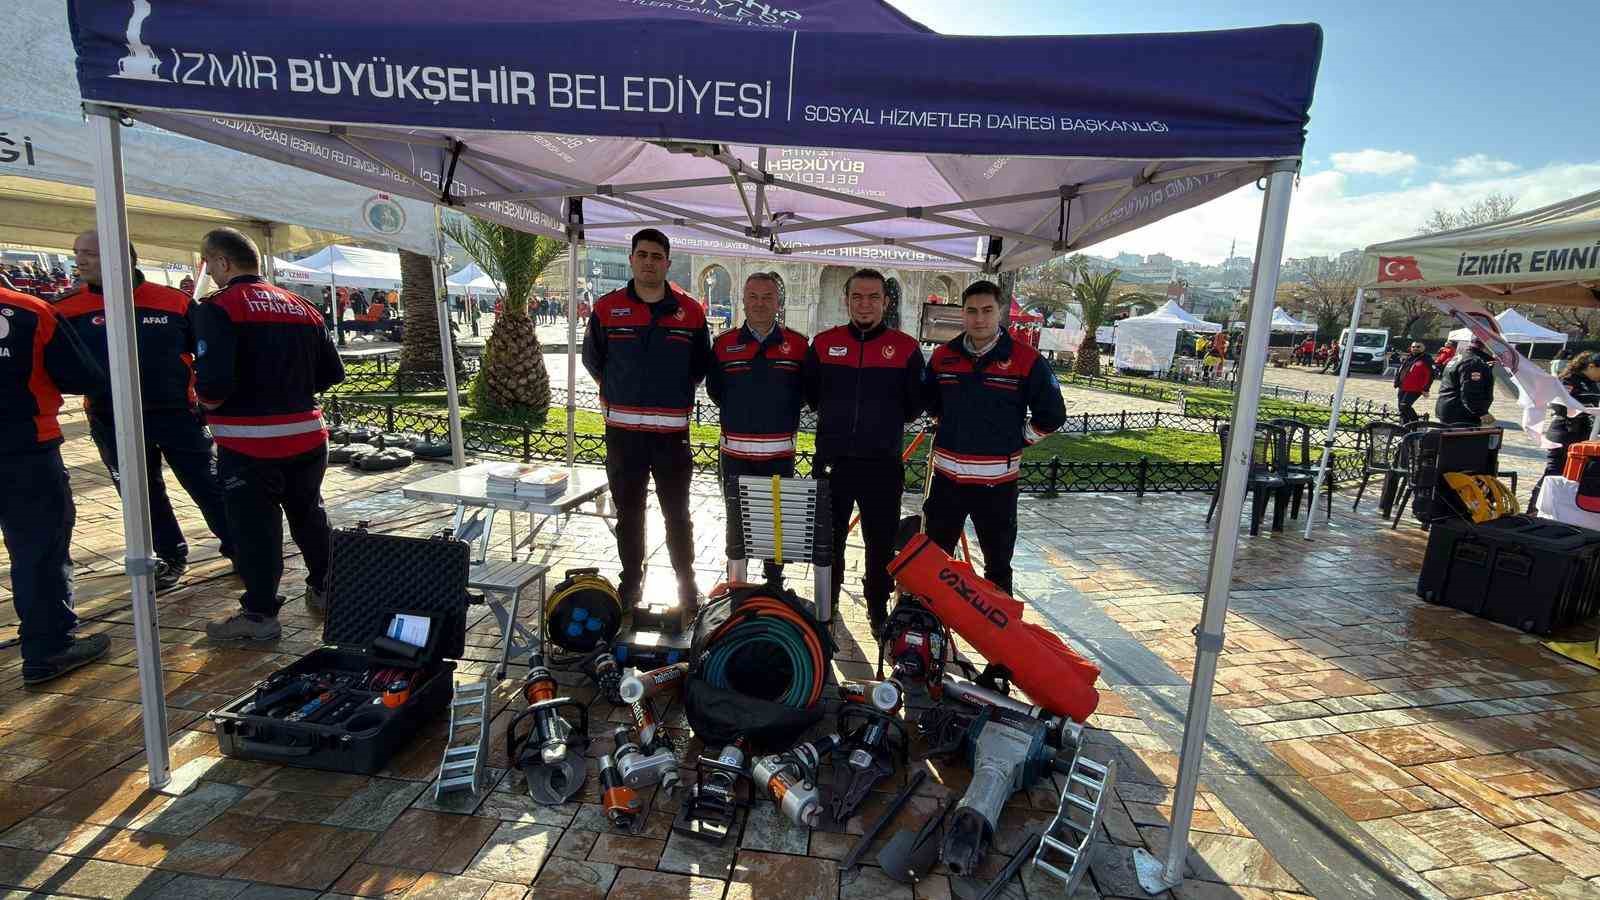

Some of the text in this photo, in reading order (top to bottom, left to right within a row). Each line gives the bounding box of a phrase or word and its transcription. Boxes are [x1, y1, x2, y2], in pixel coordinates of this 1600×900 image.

[170, 47, 772, 119] İZMİR BÜYÜKŞEHİR BELEDİYESİ
[804, 105, 874, 125] SOSYAL
[880, 108, 982, 129] HİZMETLER
[987, 112, 1056, 131] DAİRESİ
[1456, 249, 1522, 277] İZMİR
[143, 315, 168, 325] AFAD
[939, 567, 1009, 630] SKED
